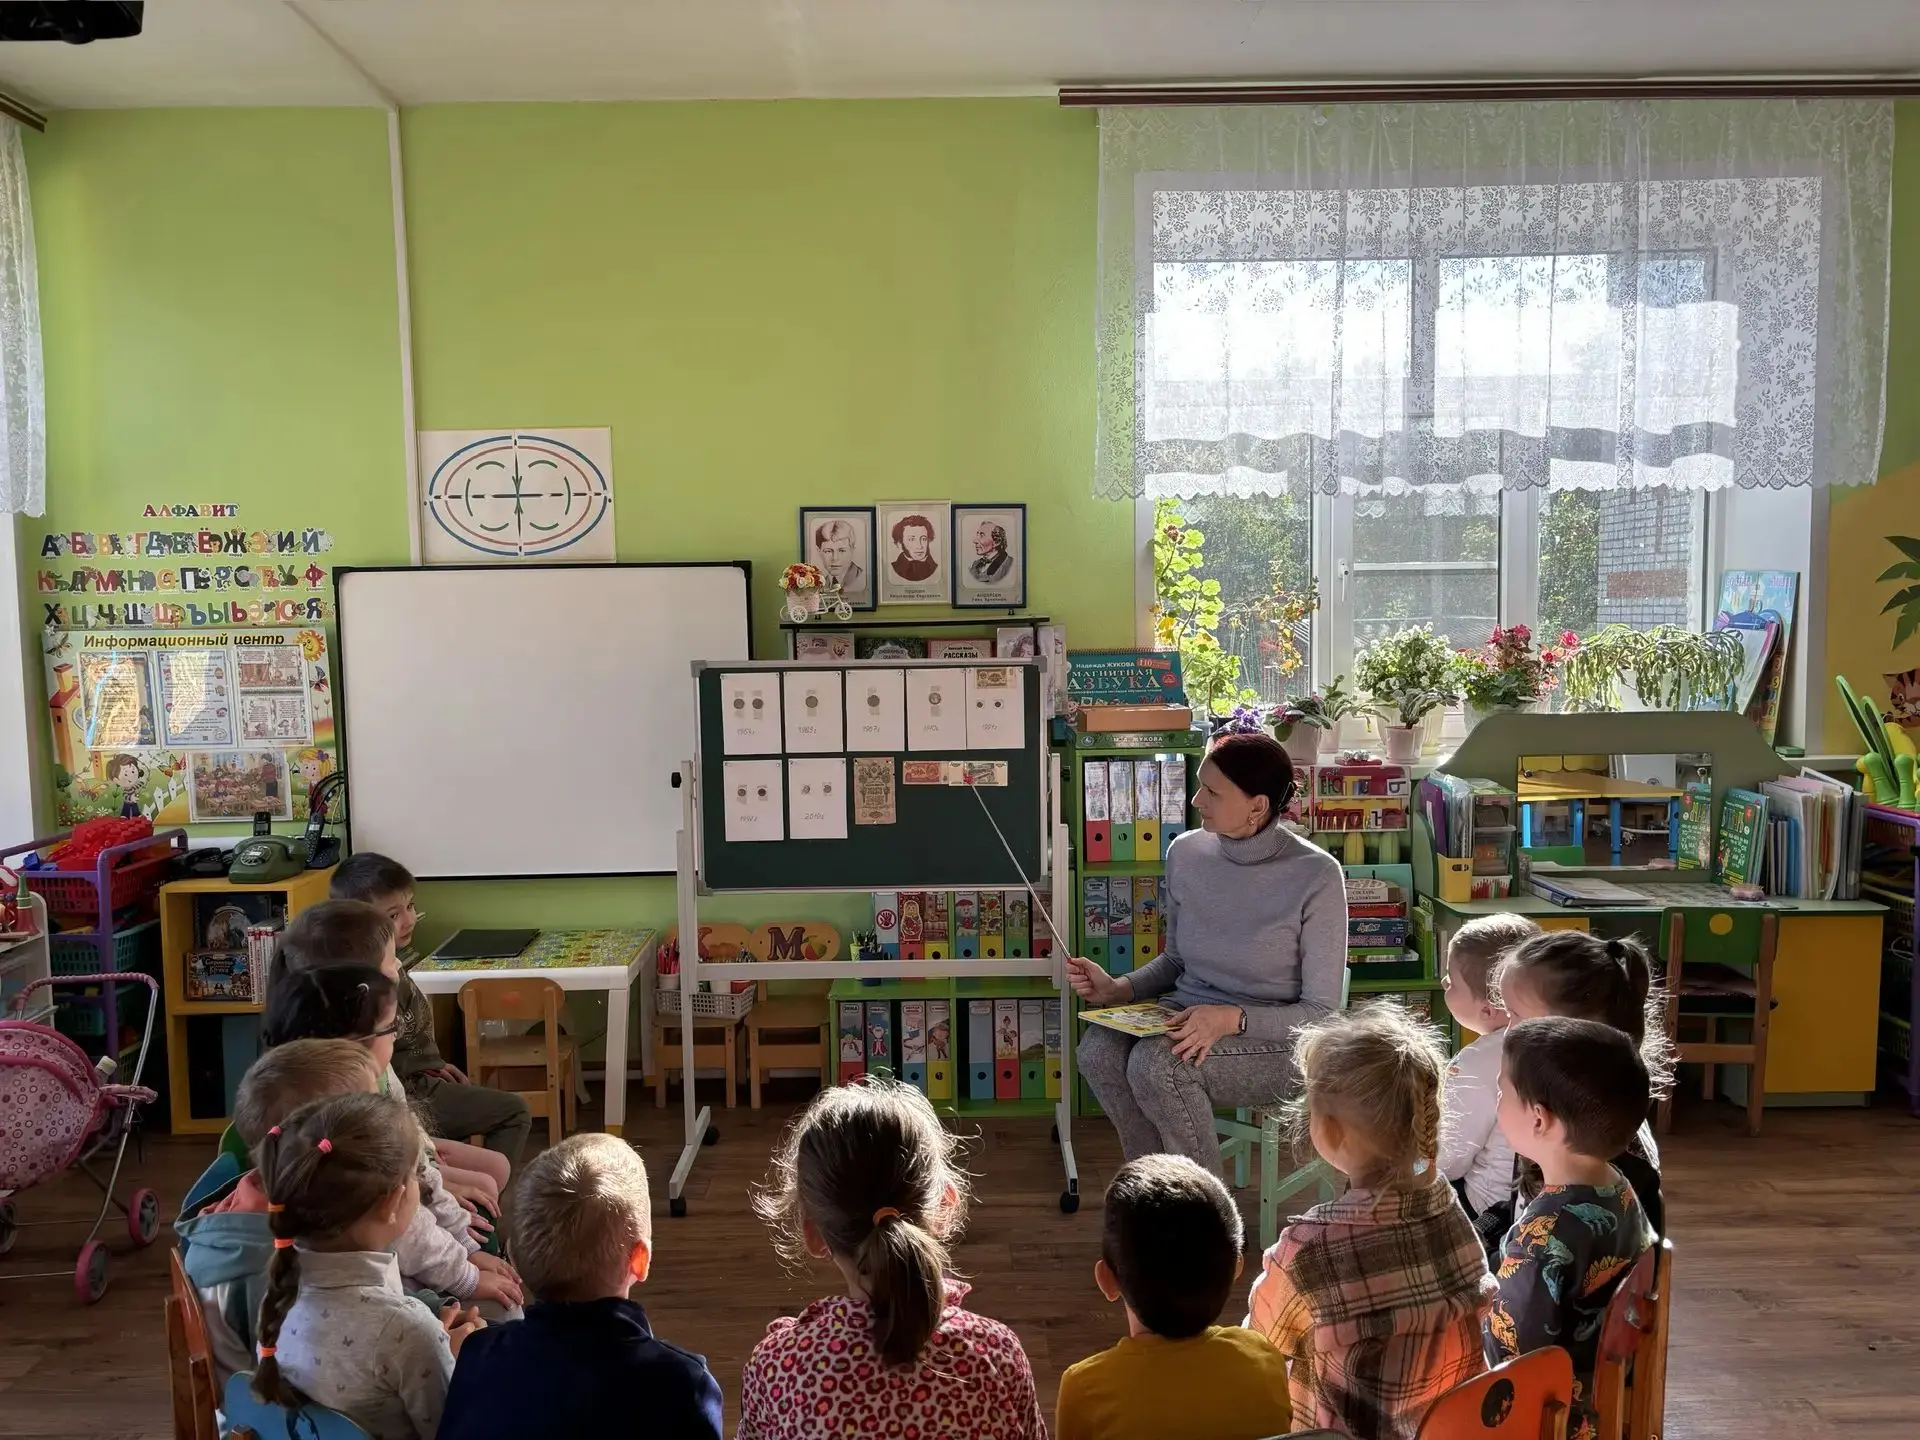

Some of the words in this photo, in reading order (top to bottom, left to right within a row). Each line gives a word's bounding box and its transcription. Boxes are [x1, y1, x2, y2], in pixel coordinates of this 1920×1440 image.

[143, 504, 239, 517] АЛФАВИТ
[84, 633, 228, 649] Информационный
[234, 634, 285, 647] центр
[1072, 669, 1153, 677] МАГНИТНАЯ
[1068, 675, 1160, 689] АЗБУКА
[767, 927, 806, 960] М
